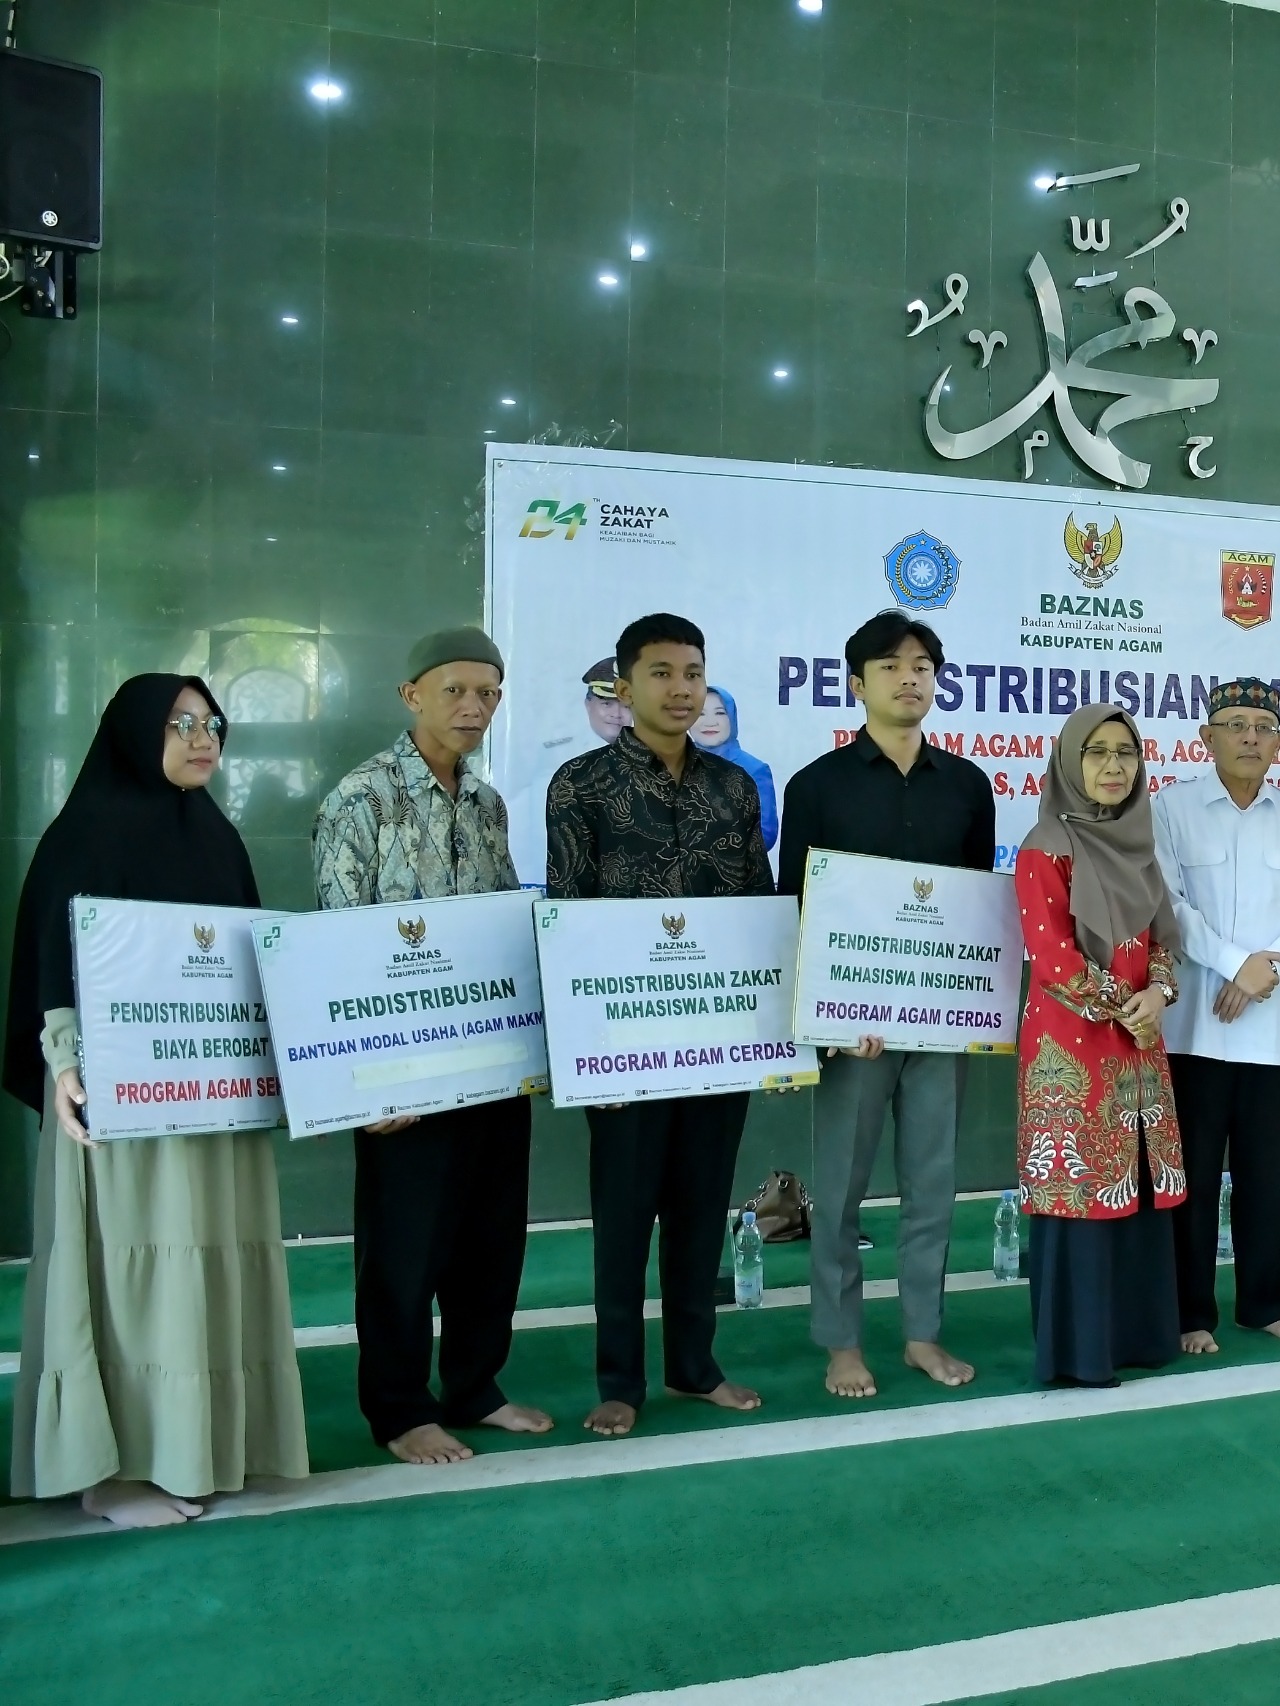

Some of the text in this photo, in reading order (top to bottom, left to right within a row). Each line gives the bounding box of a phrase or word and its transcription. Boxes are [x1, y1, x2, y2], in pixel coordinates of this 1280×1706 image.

[600, 504, 669, 518] CAHAYA
[600, 516, 653, 529] ZAKAT
[1228, 553, 1268, 563] AGAM
[1040, 594, 1144, 619] BAZNAS
[1021, 617, 1162, 634] Badan Amil Zakat Nasional
[1020, 634, 1163, 653] KABUPATEN AGAM
[778, 656, 1219, 721] PESTRIBUSIAN
[970, 733, 1044, 759] AGAM
[904, 903, 938, 913] BAZNAS
[393, 949, 441, 963] BAZNAS
[656, 941, 697, 949] BAZNAS
[828, 932, 1001, 962] PENDISTRIBUSIAN ZAKAT
[188, 955, 225, 965] BAZNAS
[387, 965, 453, 978] KABUPATEN AGAM
[571, 968, 782, 997] PENDISTRIBUSIAN ZAKAT
[830, 964, 994, 992] MAHASISWA INSIDENTIL
[328, 977, 517, 1023] PENDISTRIBUSIAN
[605, 994, 758, 1020] MAHASISWA BARU
[111, 1003, 249, 1023] PENDISTRIBUSIAN
[816, 1001, 1002, 1029] PROGRAM AGAM CERDAS
[288, 1010, 543, 1062] BANTUAN MODAL USAHA (AGAM MAKM
[153, 1037, 268, 1059] BIAYA BEROBAT
[576, 1041, 797, 1076] PROGRAM AGAM CERDAS
[116, 1081, 200, 1104] PROGRAM
[207, 1078, 252, 1099] AGAM
